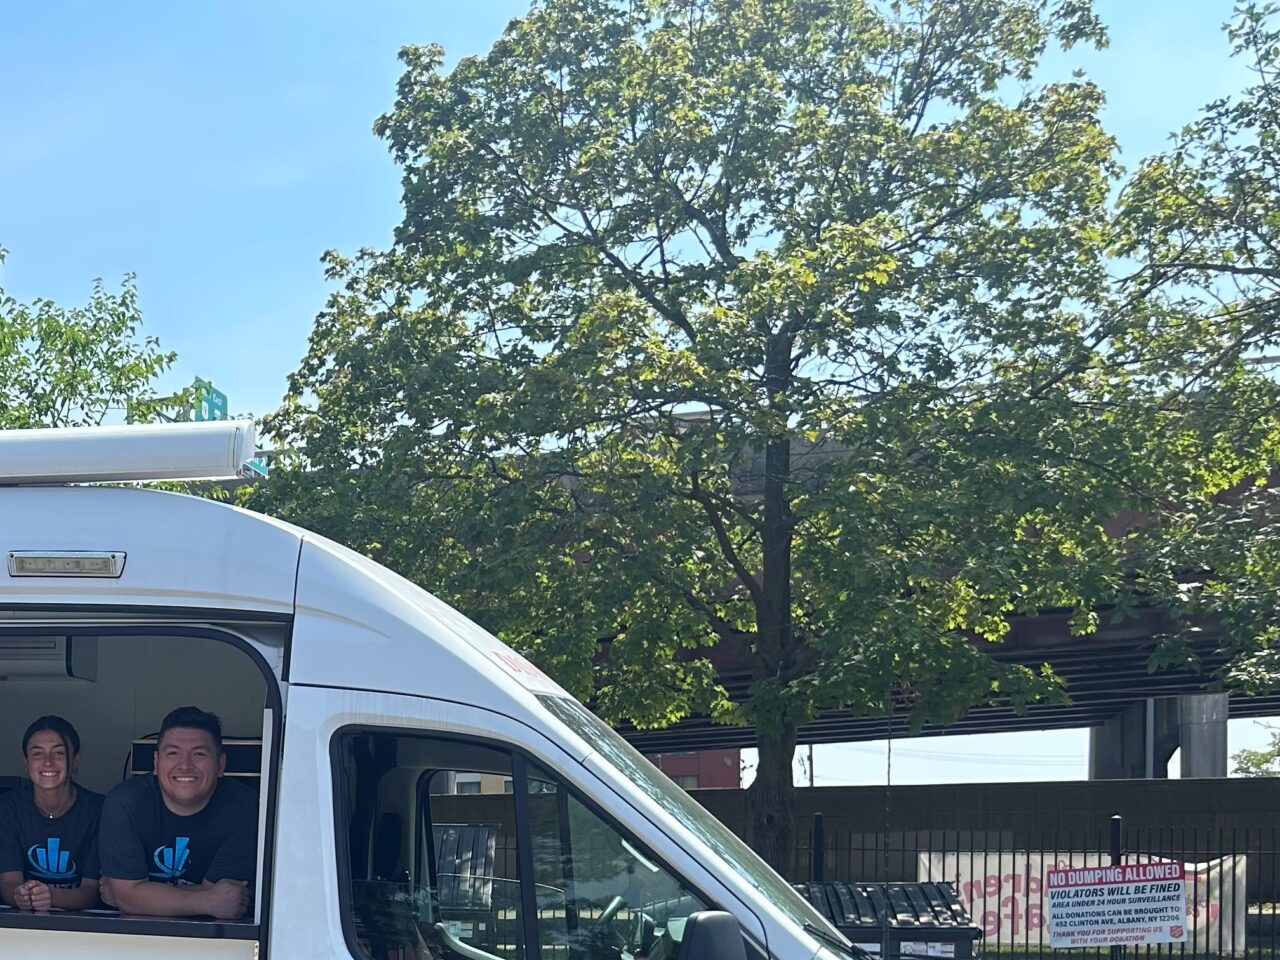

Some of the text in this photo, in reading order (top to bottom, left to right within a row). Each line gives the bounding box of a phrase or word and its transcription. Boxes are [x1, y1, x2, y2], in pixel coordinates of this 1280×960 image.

[1049, 864, 1180, 886] NO DUMPING ALLOWED
[1050, 882, 1181, 900] VIOLATORS WILL BE FINED
[1051, 894, 1181, 909] AREA UNDER 24 HOUR SURVEILLANCE
[1052, 912, 1065, 920] ALL
[1065, 910, 1106, 919] DONATIONS
[1107, 909, 1121, 917] CAN
[1123, 908, 1133, 916] BE
[1133, 907, 1168, 915] BROUGHT
[1069, 919, 1099, 927] CLINTON
[1117, 915, 1147, 924] ALBANY,
[1147, 915, 1158, 923] NY
[1159, 914, 1180, 922] 12206
[1052, 930, 1075, 938] THANK
[1076, 929, 1091, 937] YOU
[1091, 928, 1106, 936] FOR
[1107, 926, 1152, 935] SUPPORTING
[1153, 925, 1163, 933] US
[1070, 934, 1145, 945] WITH YOUR DONATION
